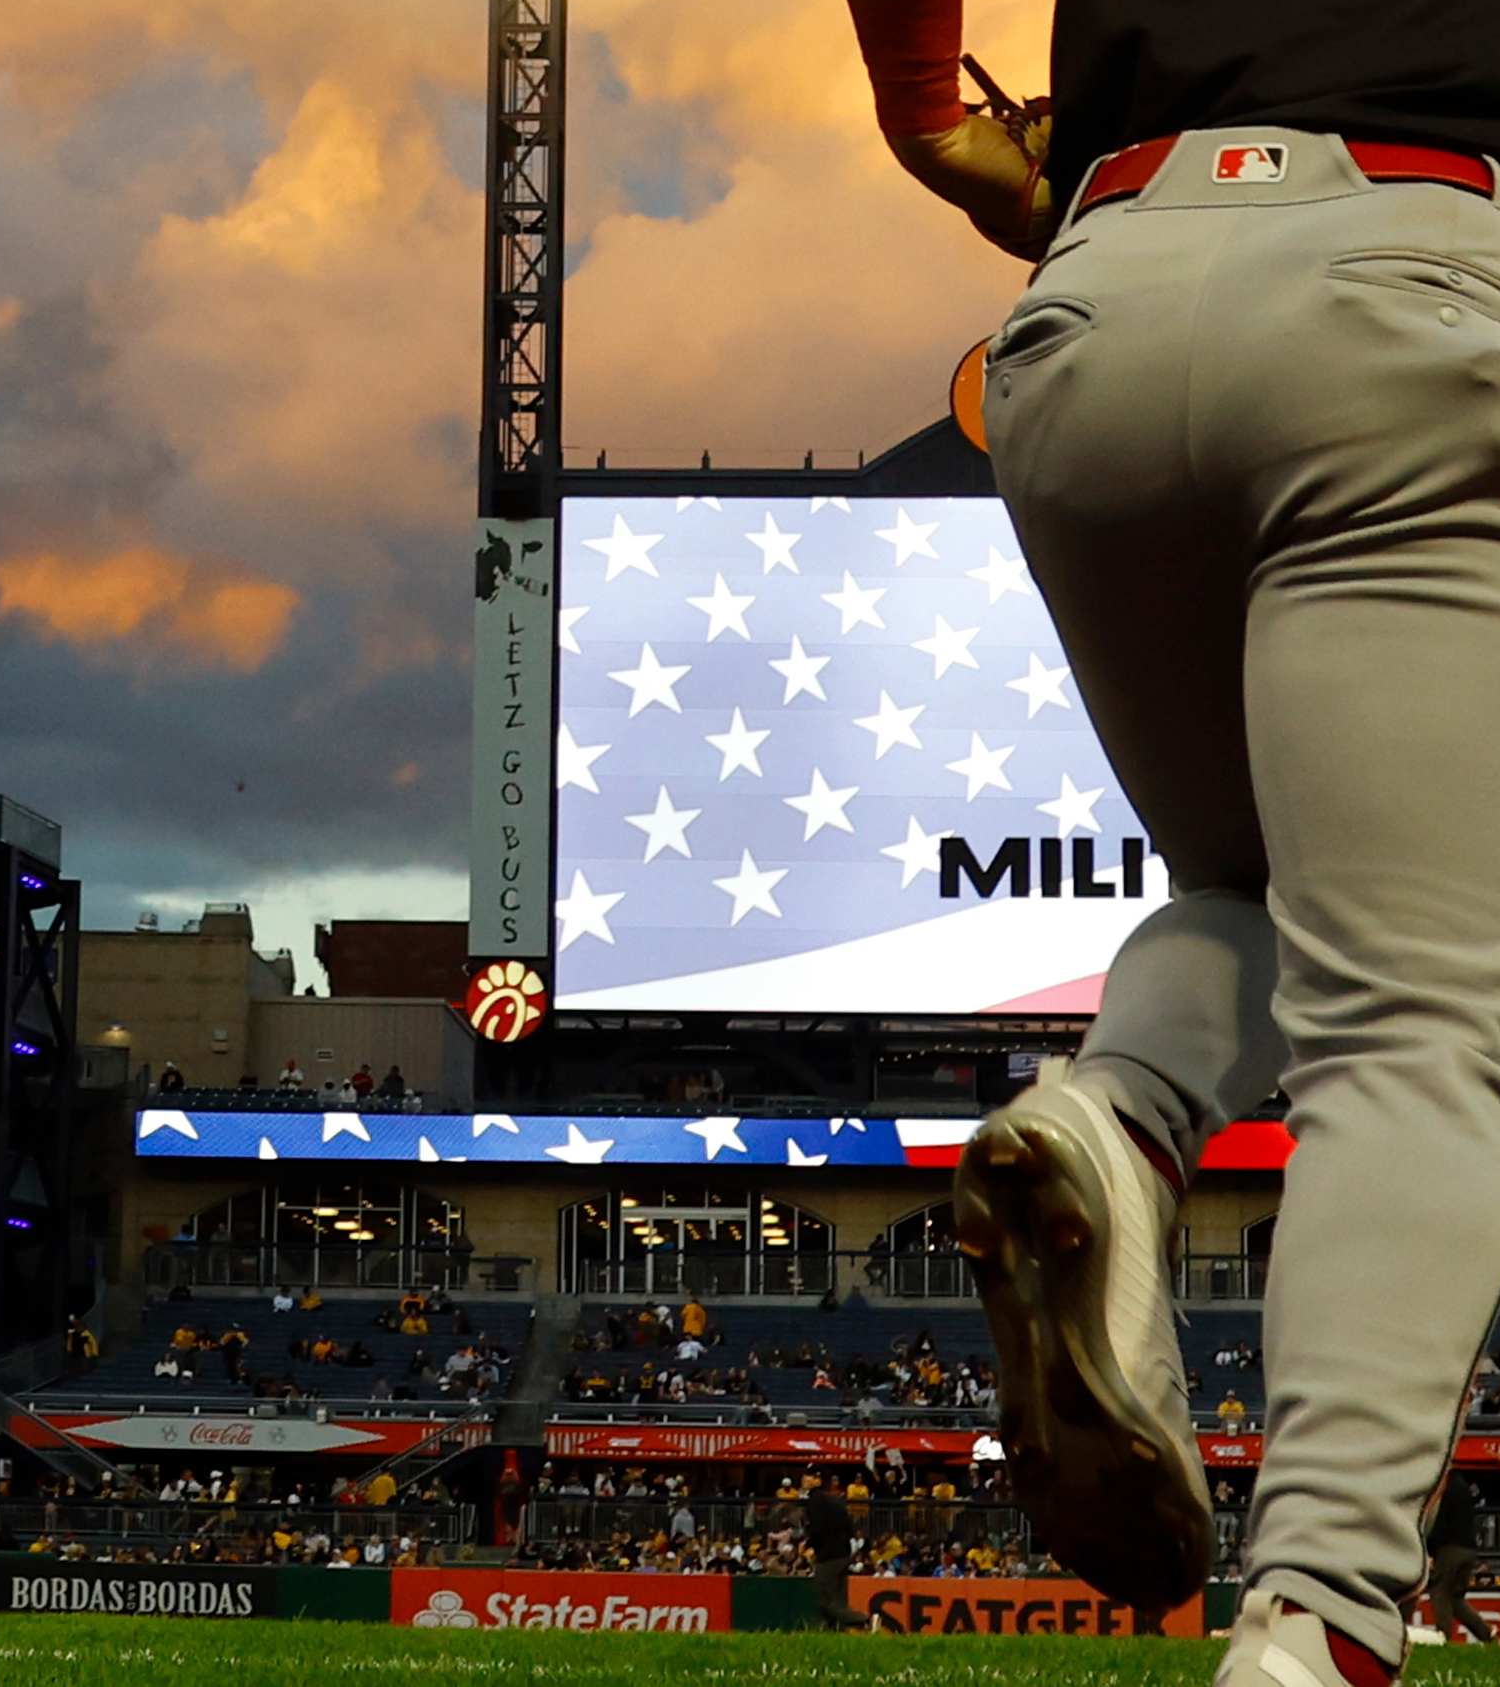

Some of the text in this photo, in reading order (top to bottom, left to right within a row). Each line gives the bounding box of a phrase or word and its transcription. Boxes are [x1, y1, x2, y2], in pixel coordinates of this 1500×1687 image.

[501, 612, 526, 944] LETZ GO BUCS
[939, 837, 1160, 898] MILI
[11, 1577, 125, 1611] BORDAS
[138, 1580, 253, 1616] BORDAS
